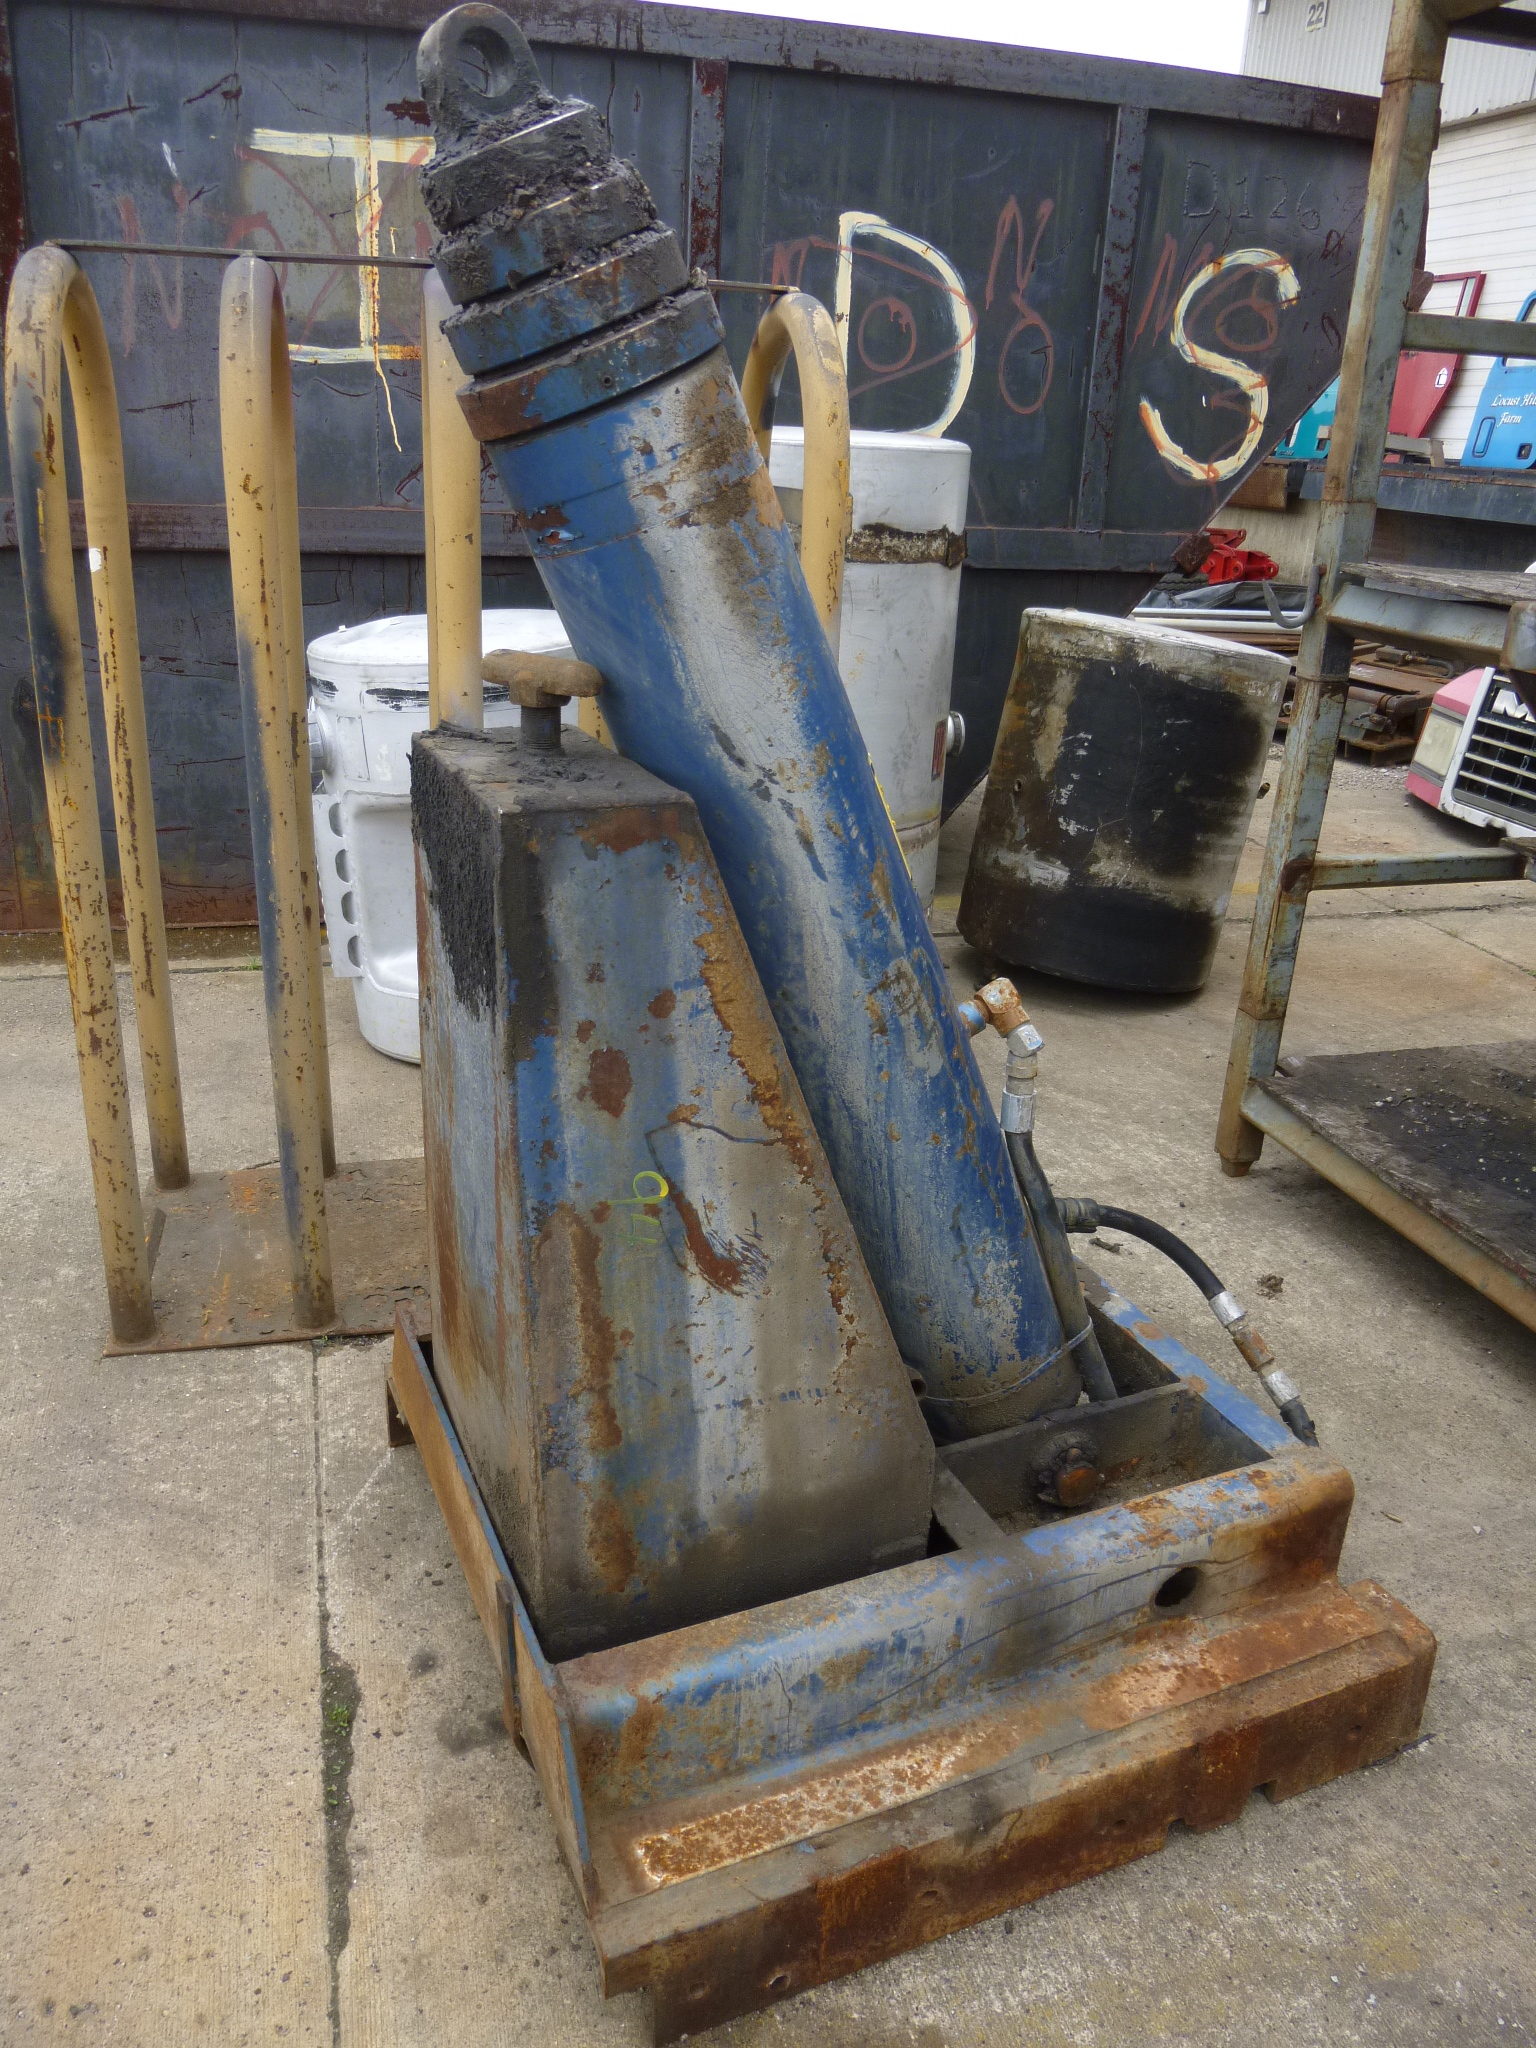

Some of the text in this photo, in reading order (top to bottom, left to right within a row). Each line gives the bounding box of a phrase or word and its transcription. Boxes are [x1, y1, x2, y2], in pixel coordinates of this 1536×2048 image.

[1307, 2, 1325, 27] 22
[1139, 248, 1301, 482] S
[1491, 394, 1521, 407] Locust
[1497, 412, 1521, 428] Farm
